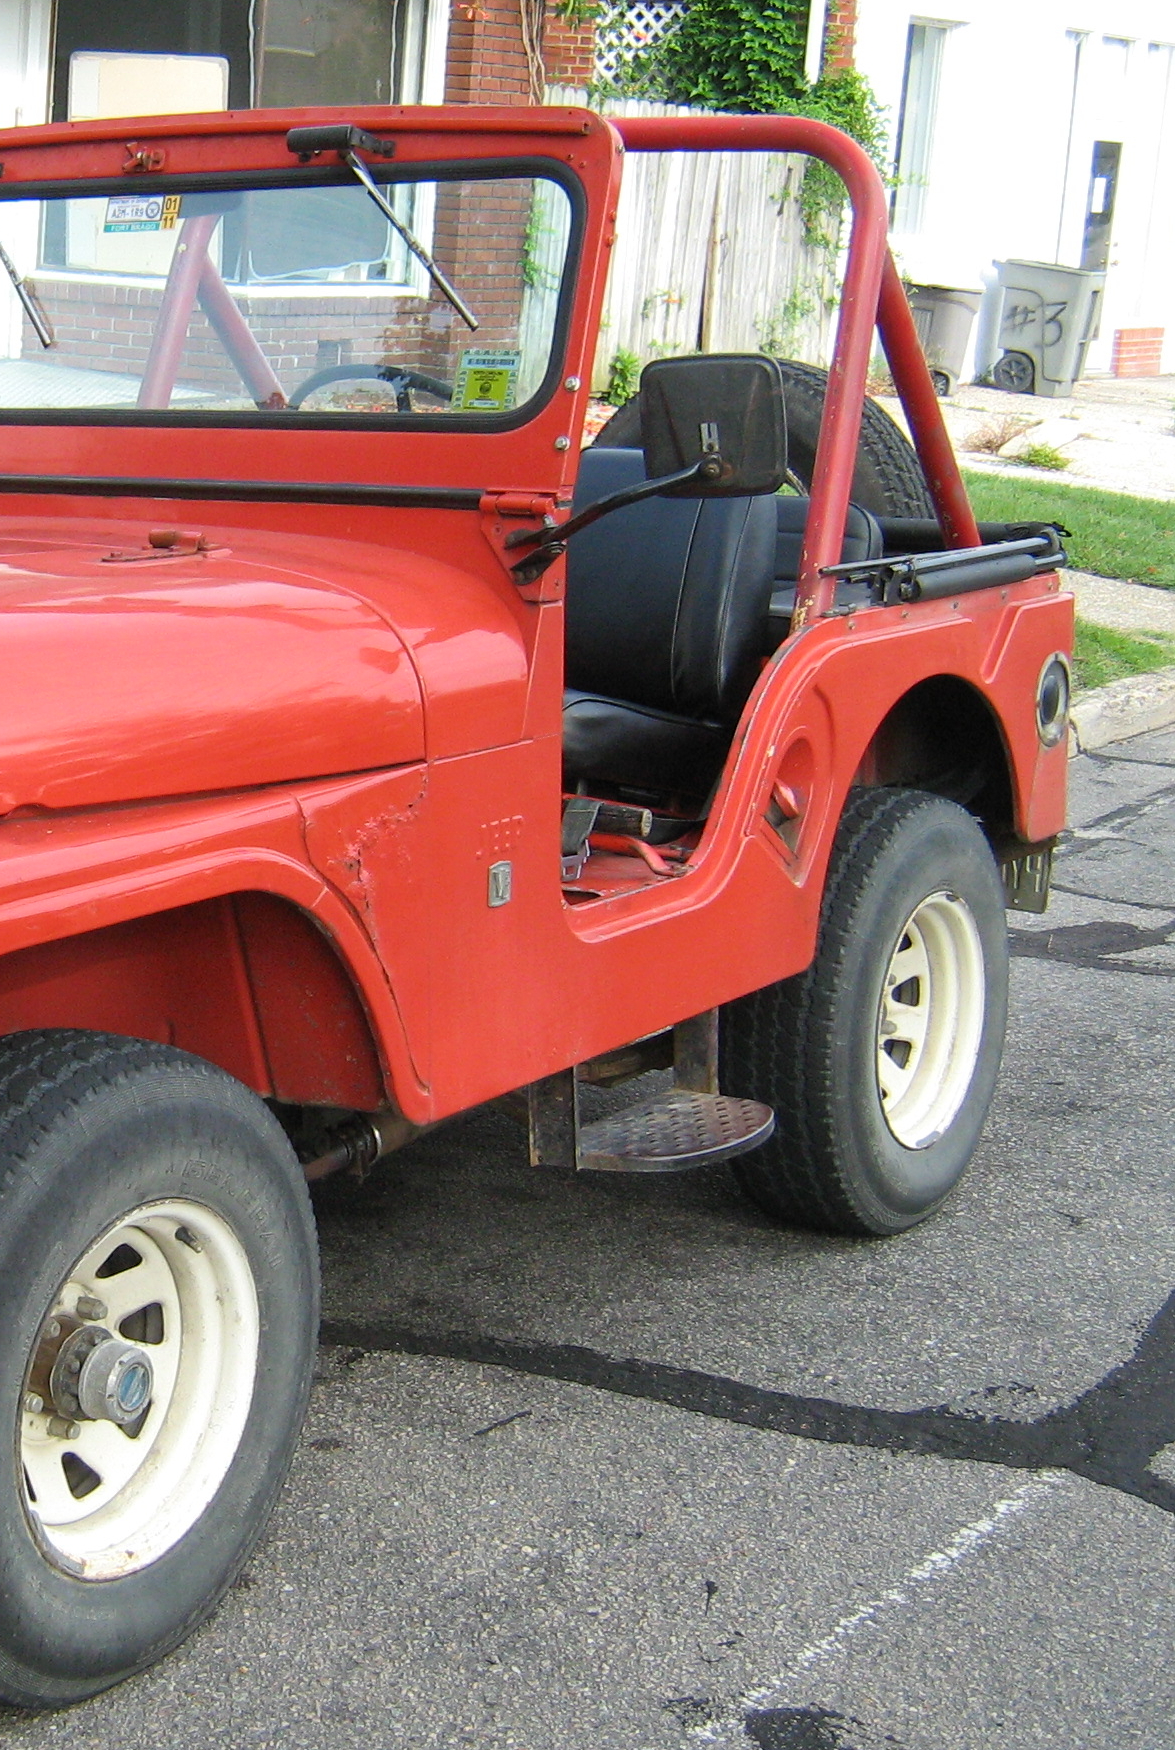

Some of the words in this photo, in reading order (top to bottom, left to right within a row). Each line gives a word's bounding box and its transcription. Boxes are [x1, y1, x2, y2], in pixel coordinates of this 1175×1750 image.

[165, 197, 177, 211] 01
[111, 224, 129, 232] FORT
[163, 216, 175, 228] 11
